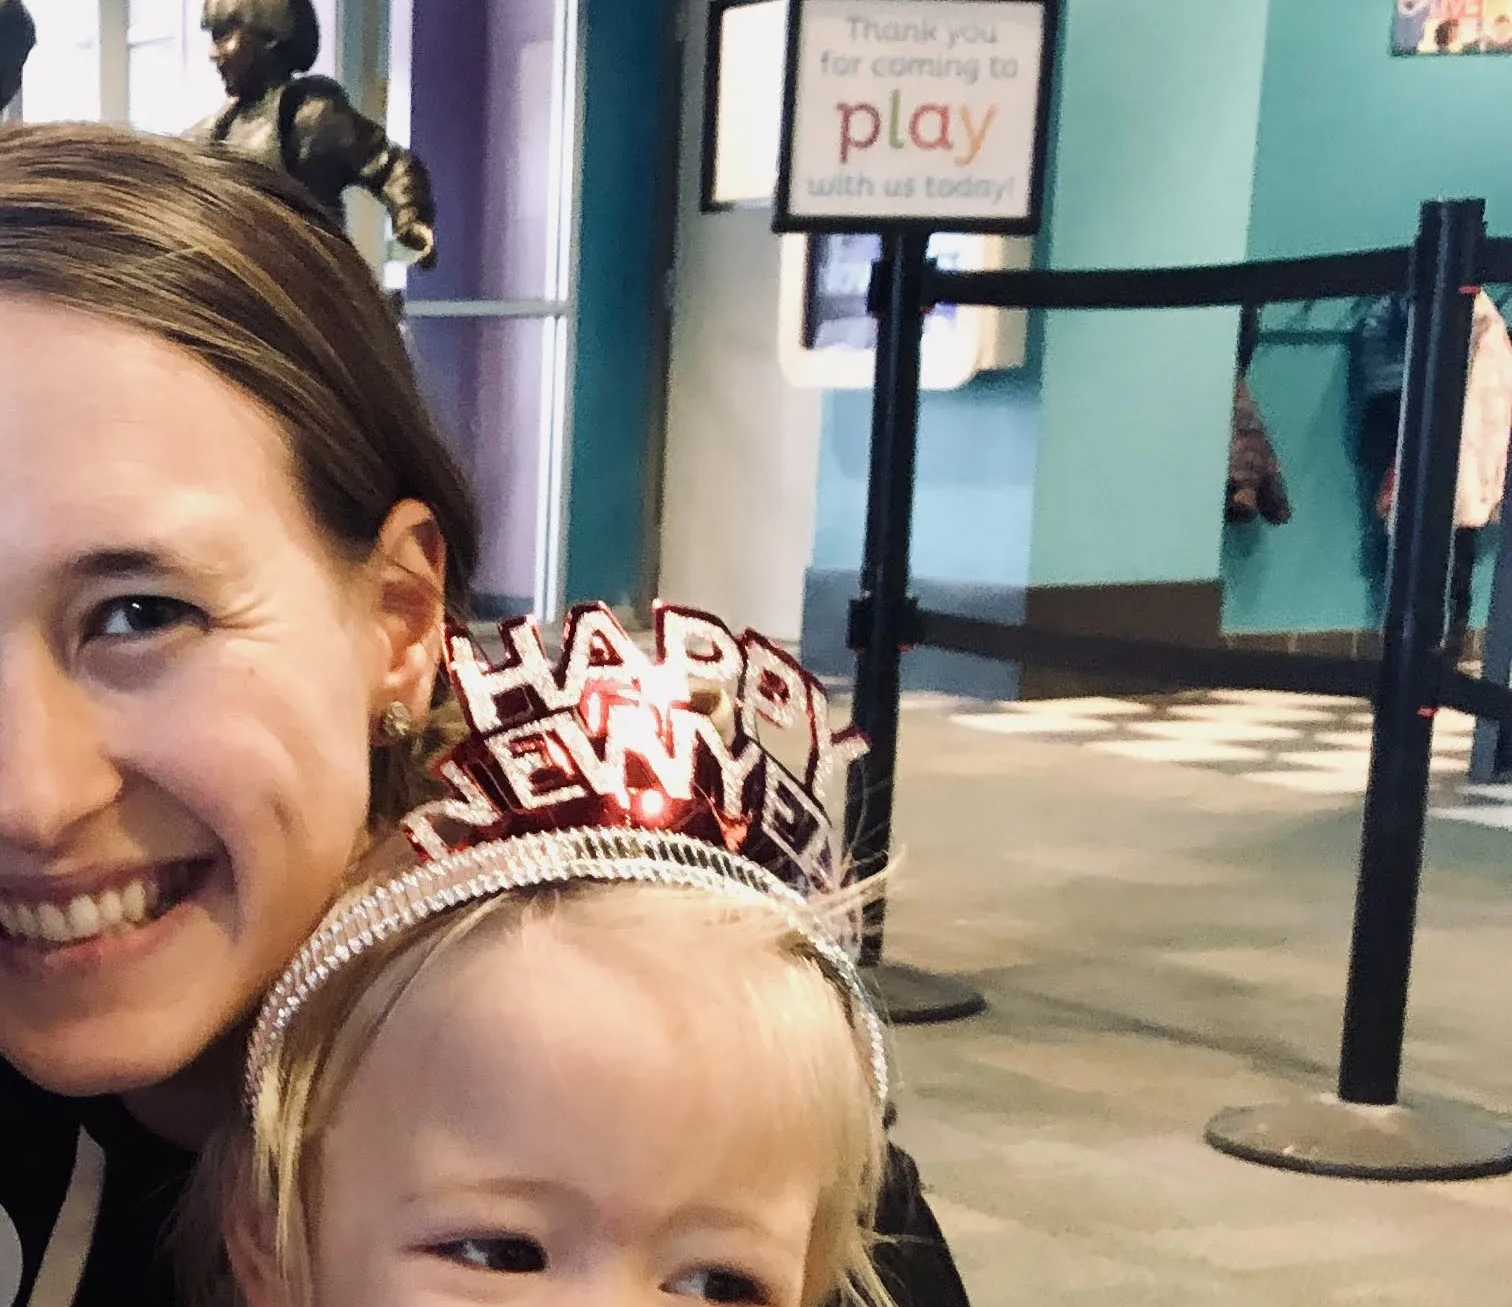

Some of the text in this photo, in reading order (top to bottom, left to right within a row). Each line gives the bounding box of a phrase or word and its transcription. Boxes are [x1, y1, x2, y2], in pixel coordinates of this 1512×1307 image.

[846, 16, 998, 49] Thank you
[820, 50, 1019, 85] for coming to
[836, 88, 996, 168] play
[807, 172, 1015, 206] with us today!
